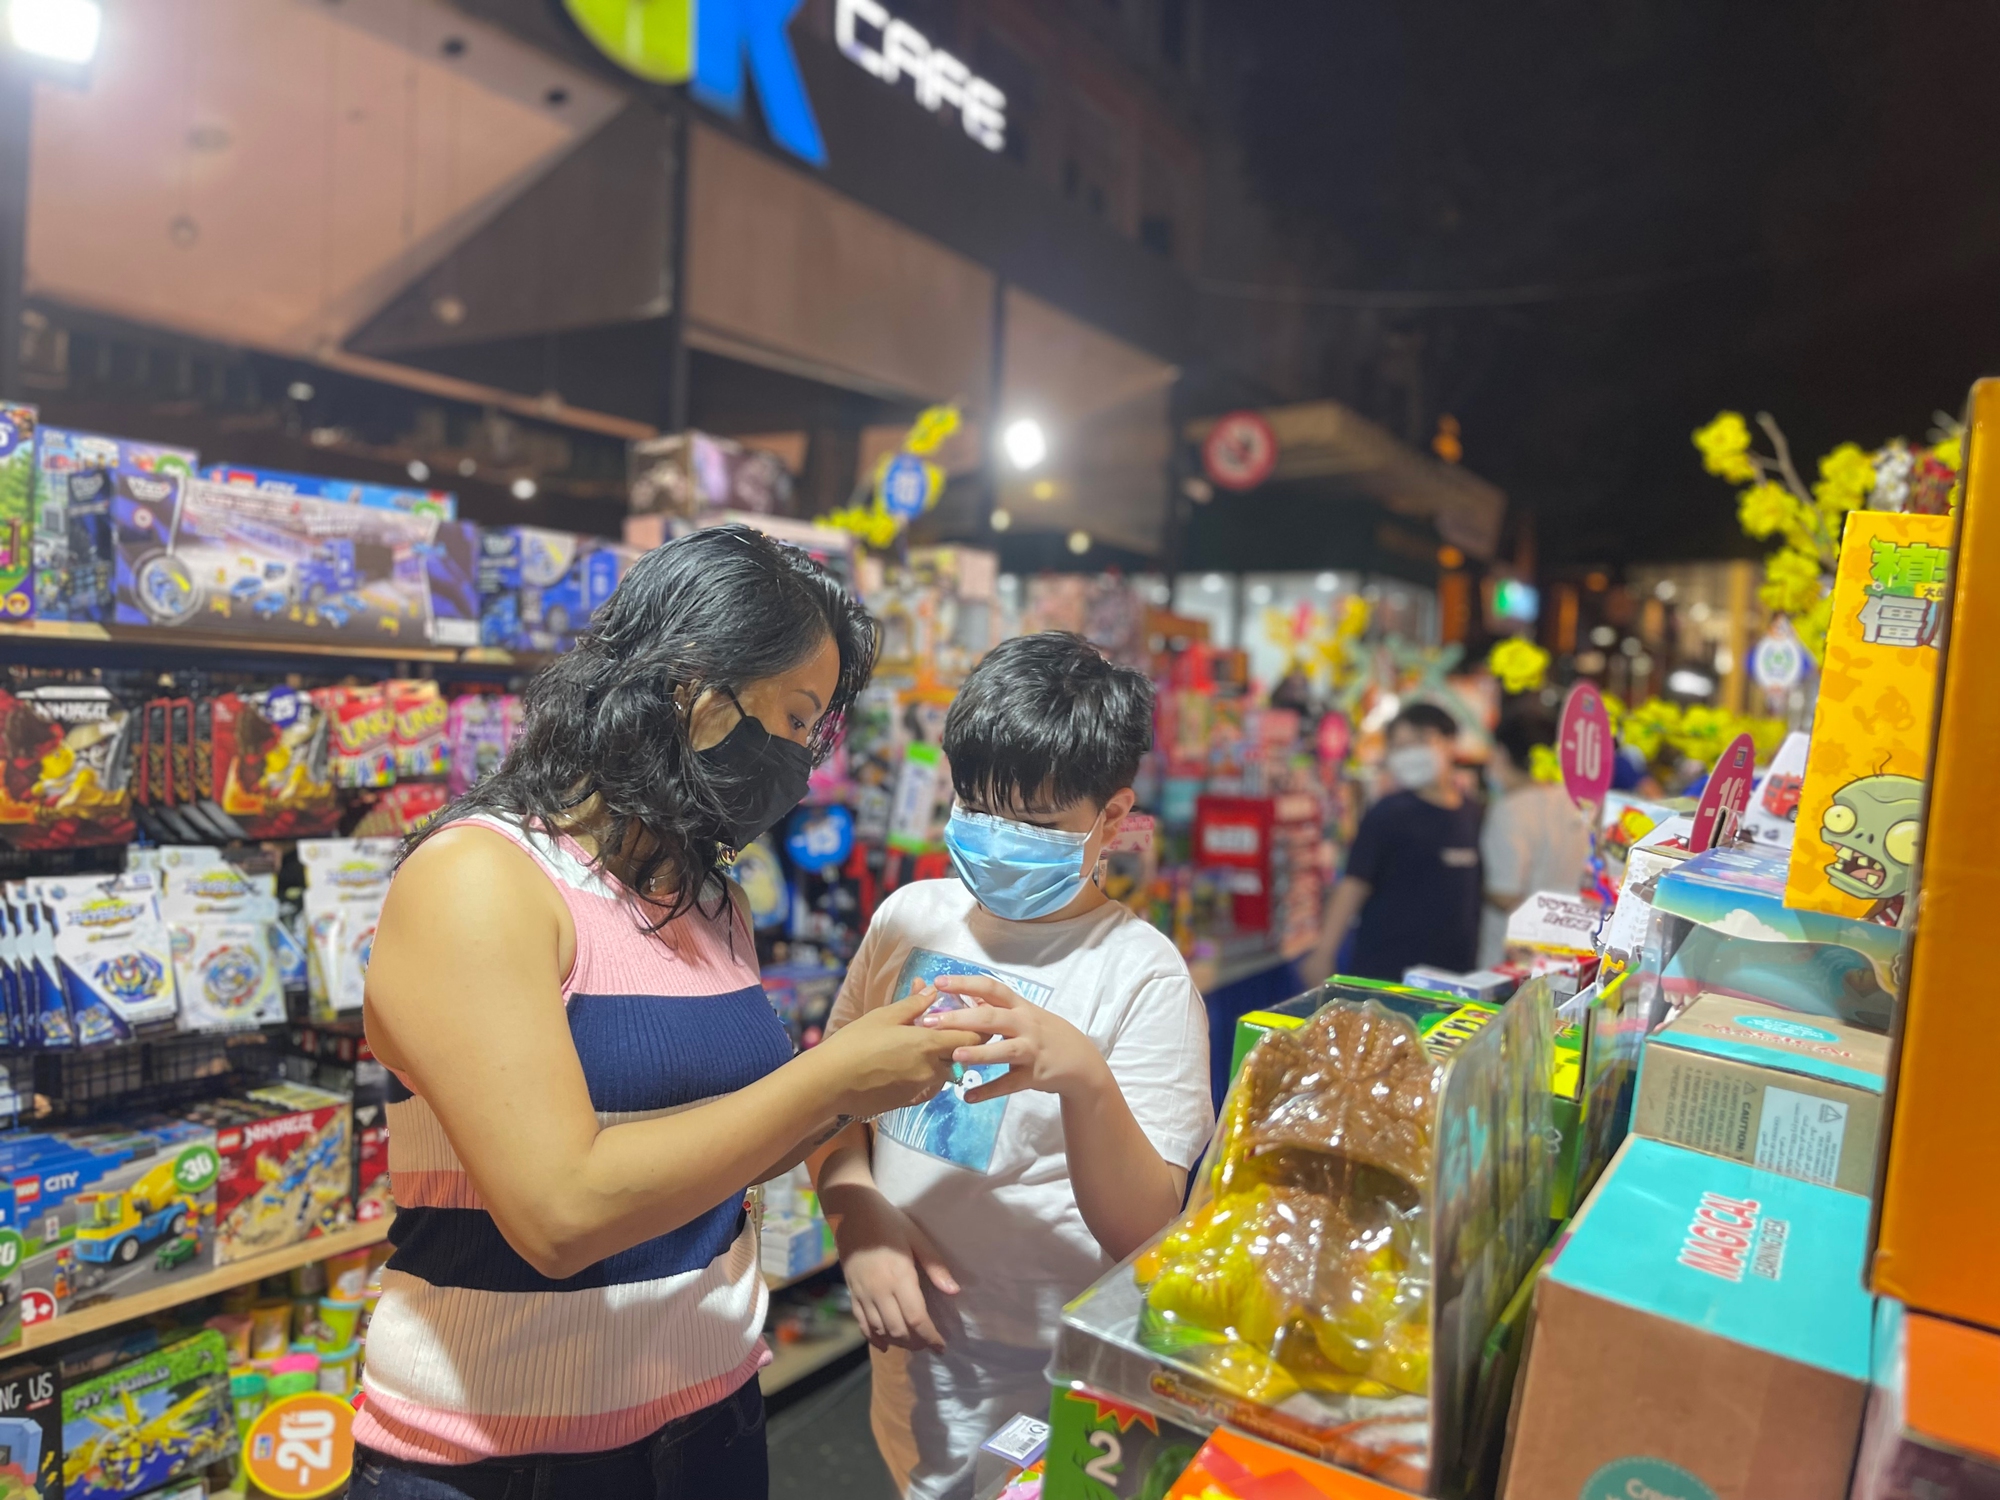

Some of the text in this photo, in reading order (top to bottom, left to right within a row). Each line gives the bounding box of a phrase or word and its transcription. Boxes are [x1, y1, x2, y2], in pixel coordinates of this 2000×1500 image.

[339, 709, 396, 748] UNO
[397, 699, 449, 738] UNO
[44, 1170, 80, 1193] CITY
[1677, 1191, 1760, 1282] MAGICAL
[28, 1371, 54, 1402] US
[1084, 1429, 1122, 1487] 2
